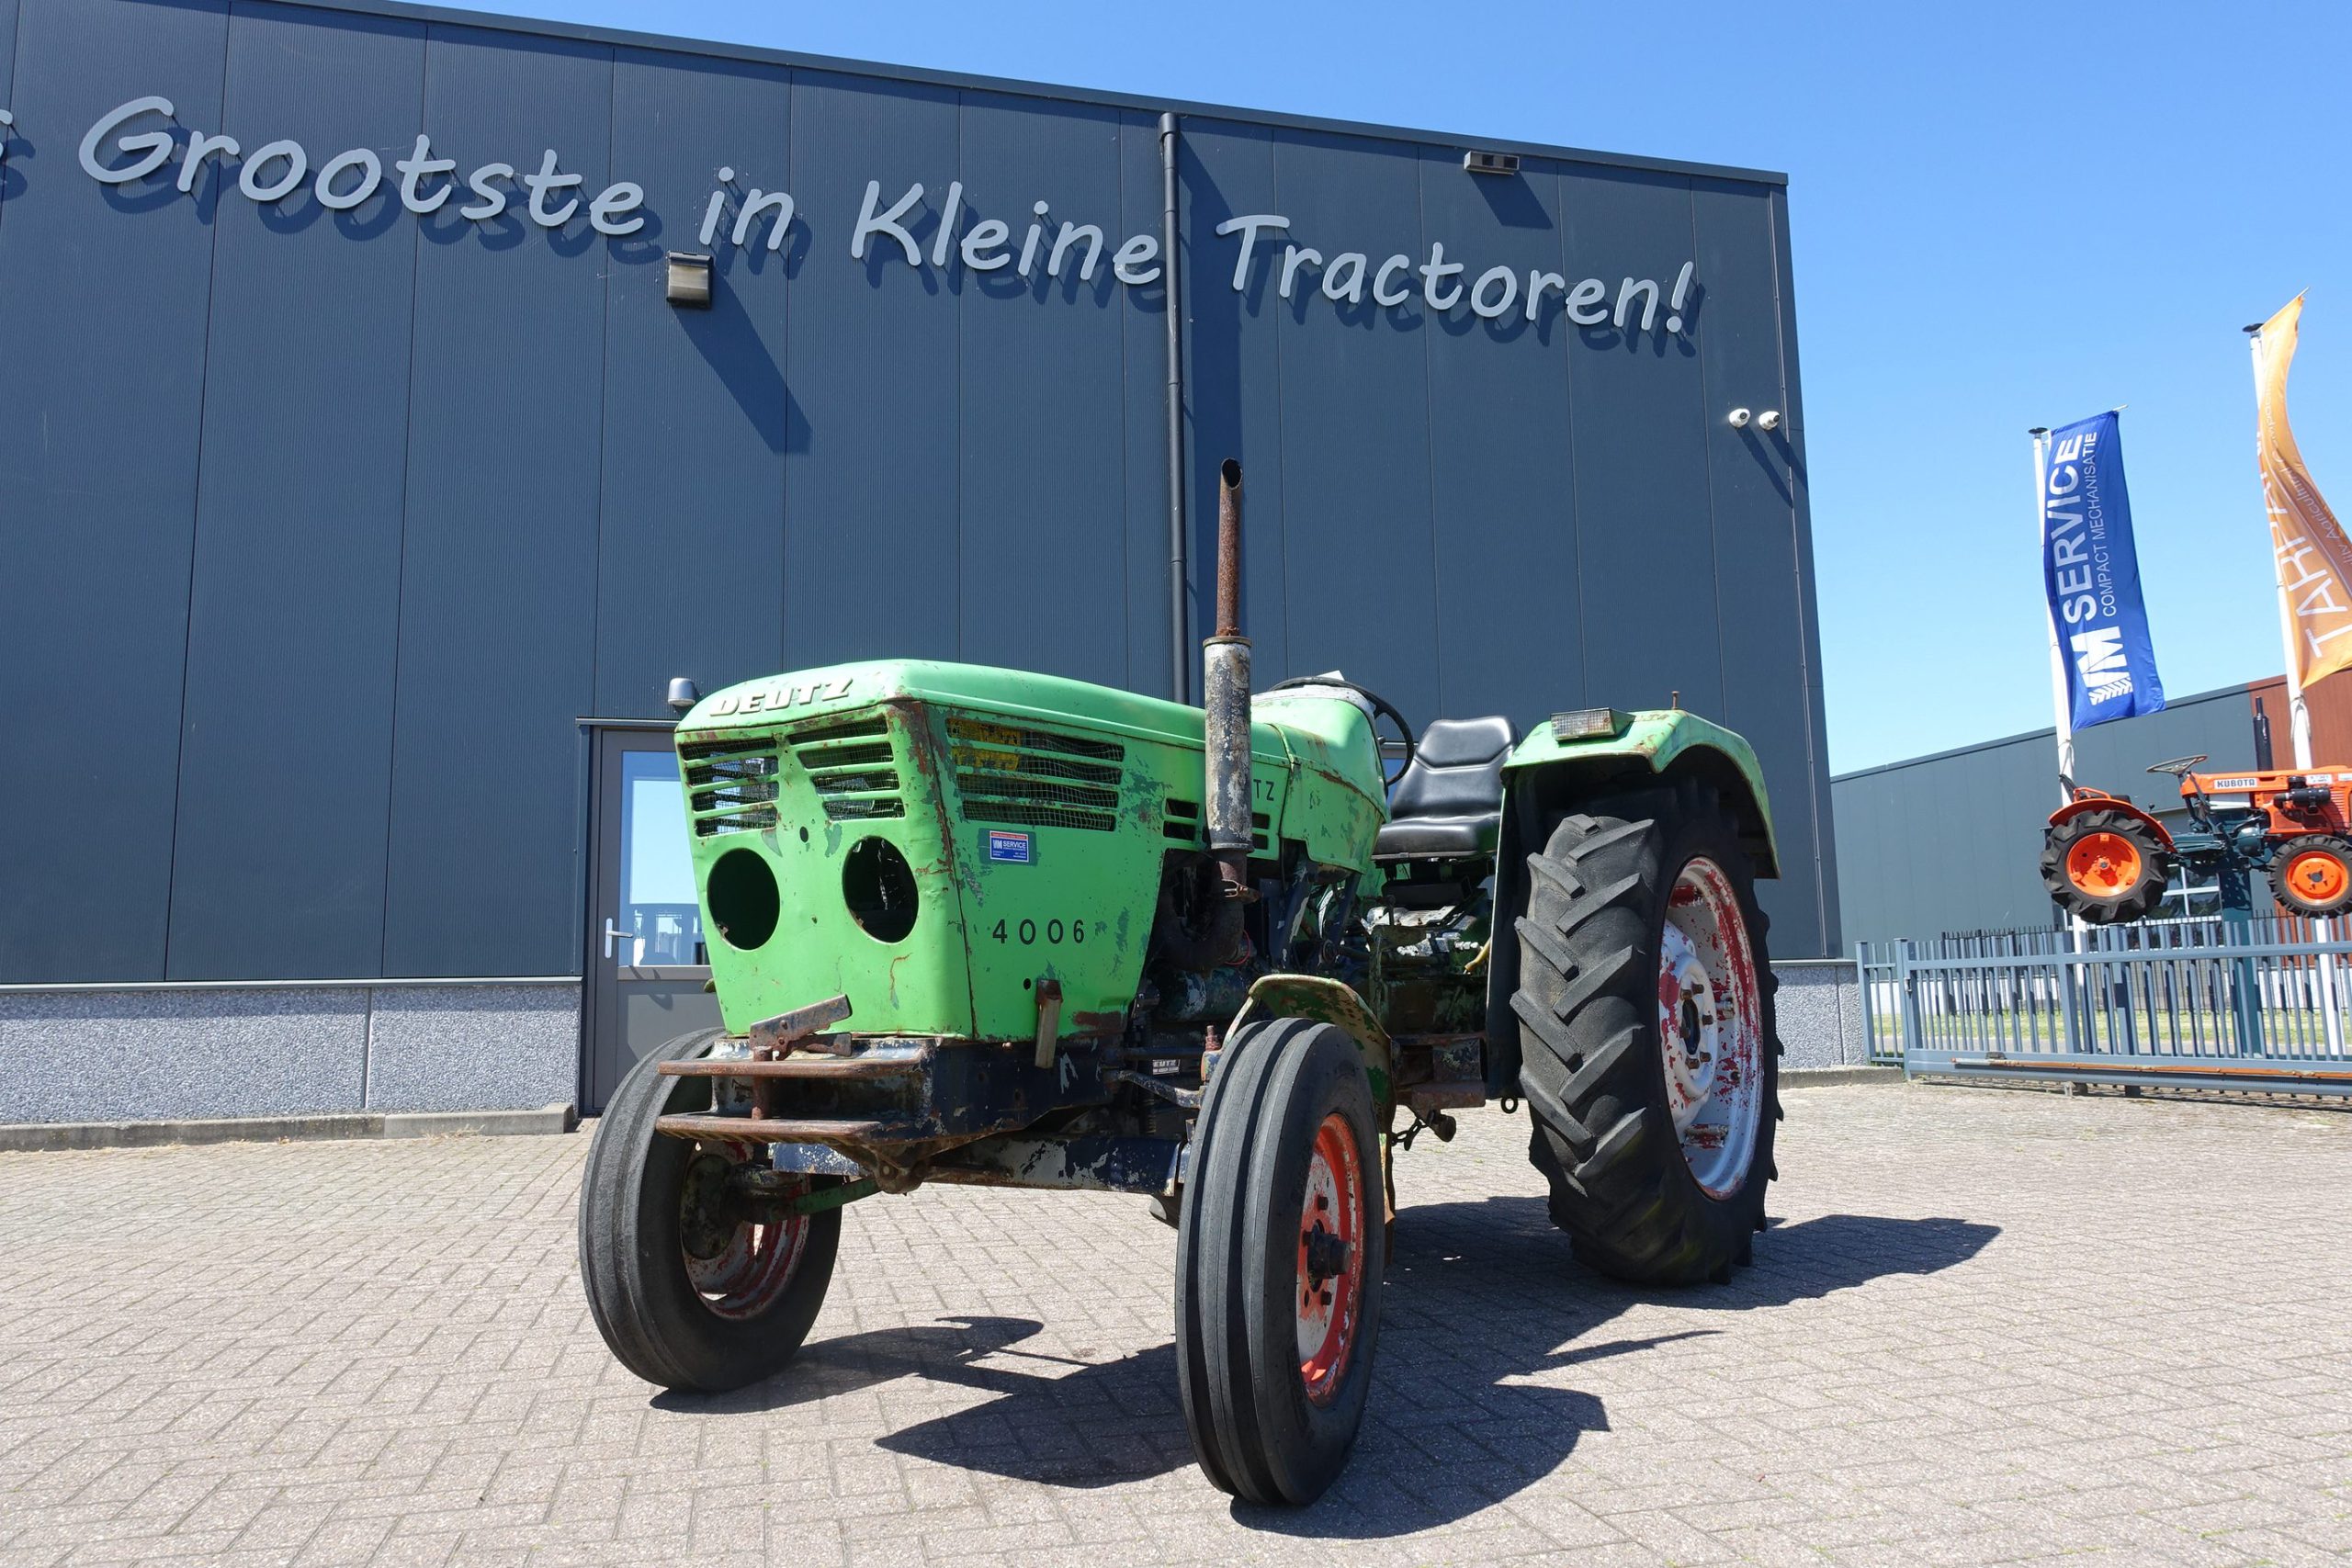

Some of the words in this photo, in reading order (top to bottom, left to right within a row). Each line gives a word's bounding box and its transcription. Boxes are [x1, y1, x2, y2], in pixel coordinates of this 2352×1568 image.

[79, 96, 644, 234] Grootste
[699, 167, 795, 249] in
[852, 181, 1160, 285] Kleine
[1216, 215, 1693, 332] Tractoren!
[2083, 432, 2106, 540] MECHANISATIE
[2047, 434, 2098, 624] SERVICE
[2093, 544, 2117, 617] COMPACT
[710, 677, 854, 716] DEUTZ
[2217, 779, 2256, 788] KUBOTA
[1002, 840, 1026, 849] SERVICE
[992, 919, 1084, 945] 4006
